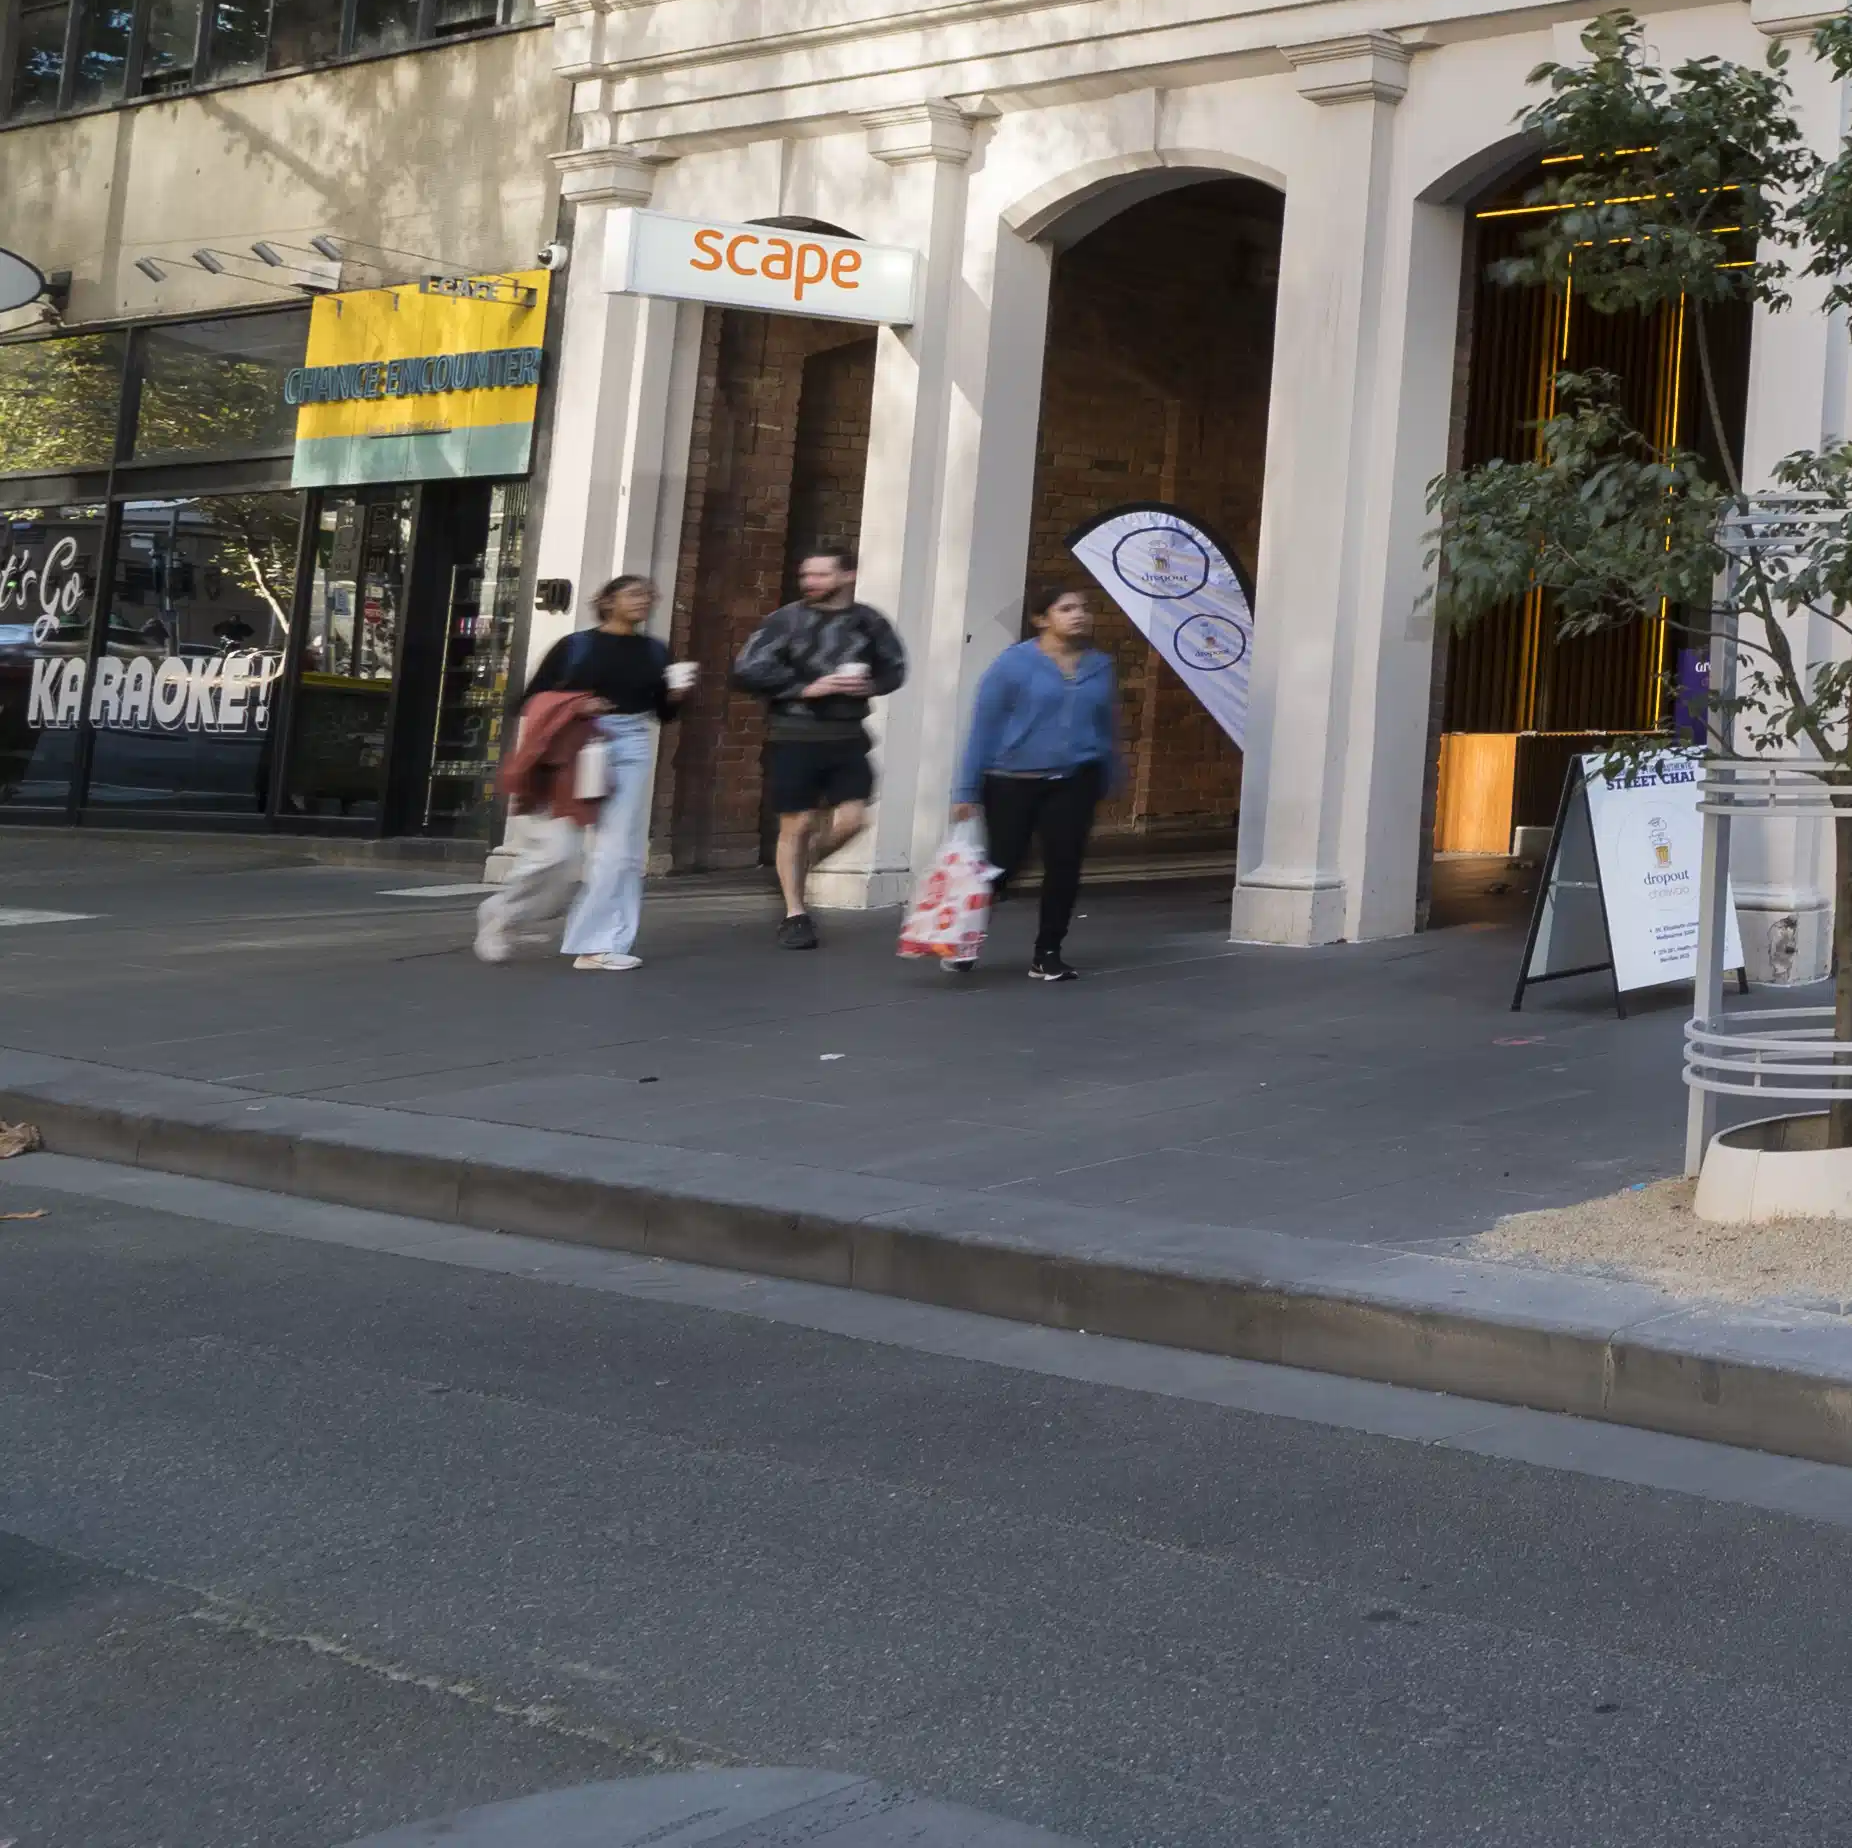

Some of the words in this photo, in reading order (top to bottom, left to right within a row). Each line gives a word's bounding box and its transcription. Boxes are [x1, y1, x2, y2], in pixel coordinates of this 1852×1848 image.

[689, 229, 863, 301] scape
[284, 361, 384, 405] CHANCE
[385, 346, 543, 397] ENCOUNTER
[33, 536, 83, 648] Go
[27, 655, 274, 733] KARAOKE!
[1661, 771, 1696, 785] CHAI
[1643, 869, 1690, 886] dropout
